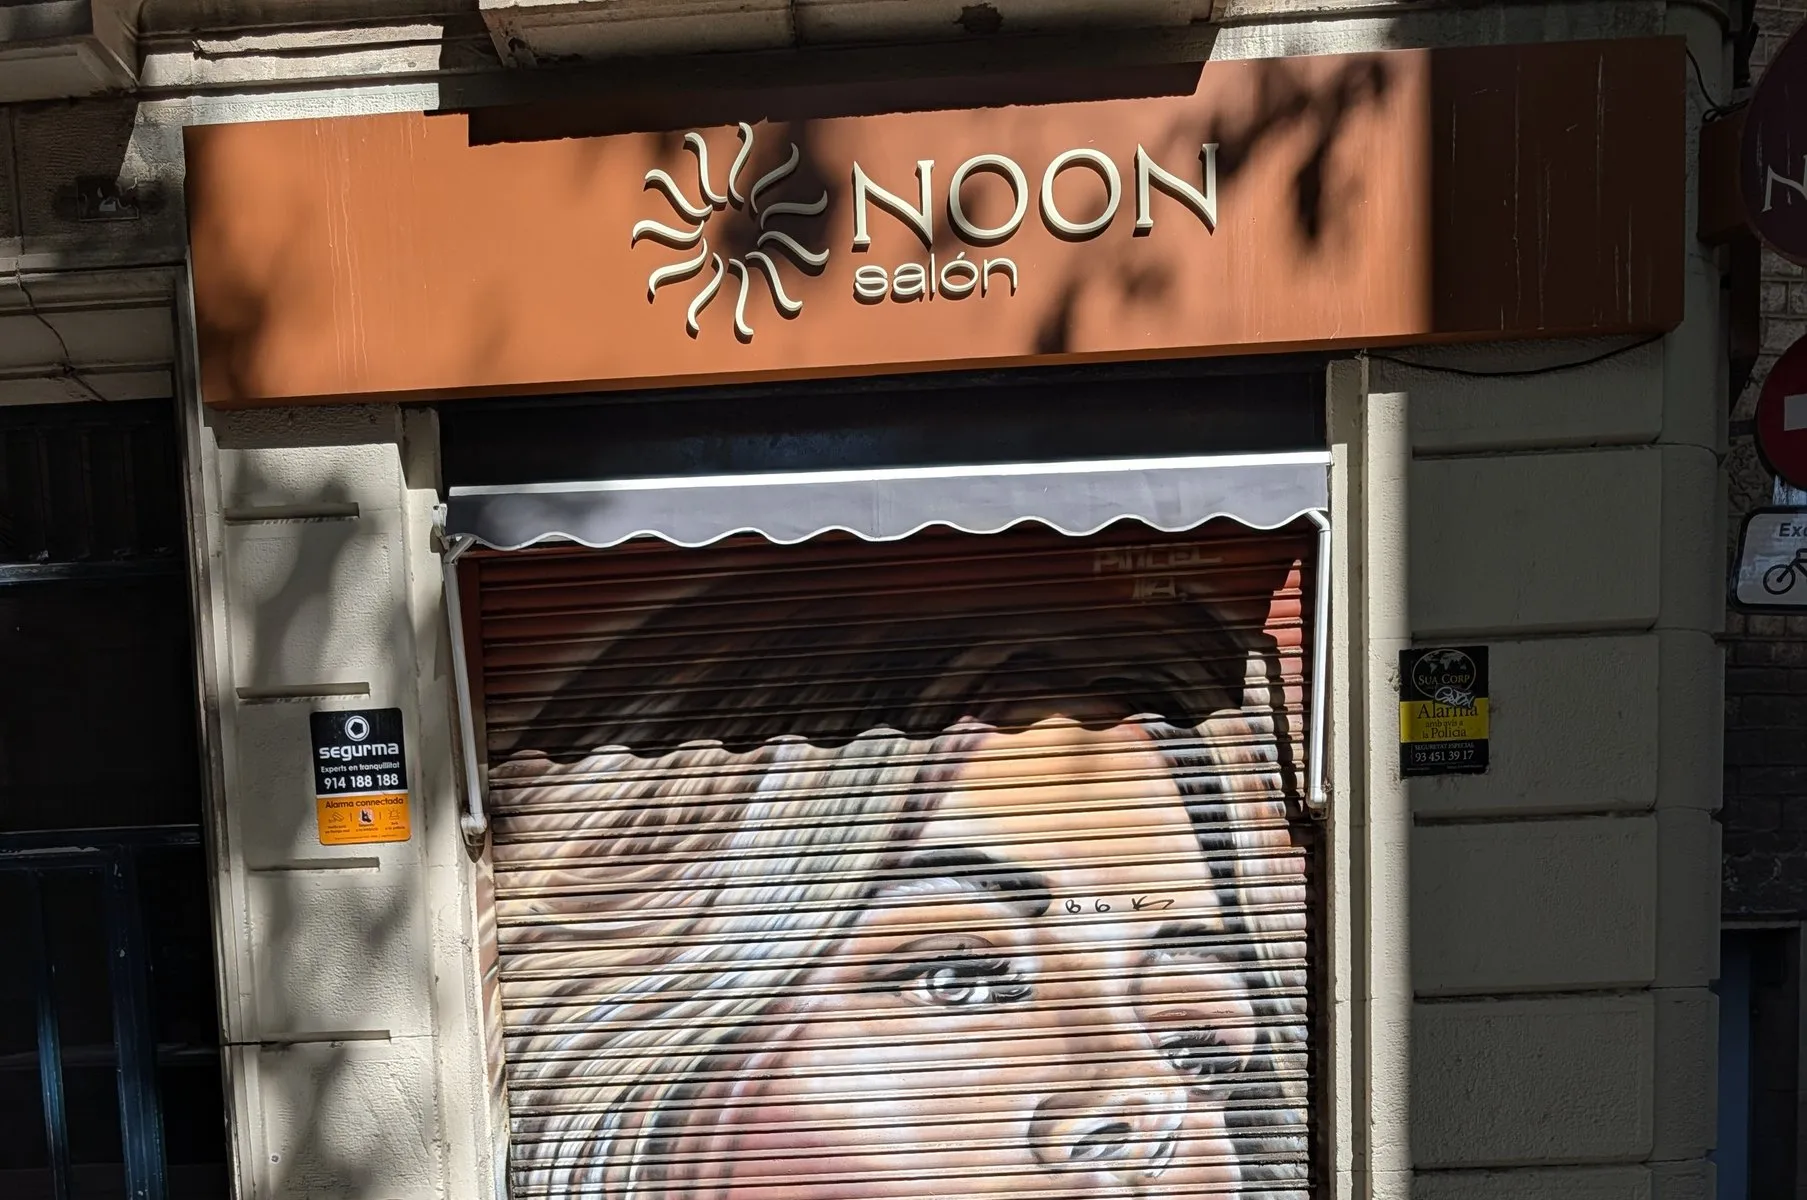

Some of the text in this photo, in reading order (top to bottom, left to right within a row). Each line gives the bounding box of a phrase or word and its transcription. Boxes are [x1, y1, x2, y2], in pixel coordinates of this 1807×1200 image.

[852, 142, 1220, 252] NOON
[853, 251, 1019, 301] salón
[319, 742, 400, 762] segurma
[1415, 749, 1474, 762] 93 451 39 17
[321, 764, 347, 774] Experts
[348, 764, 359, 772] en
[324, 773, 399, 790] 914 188 188
[325, 797, 404, 809] Alarma connectada
